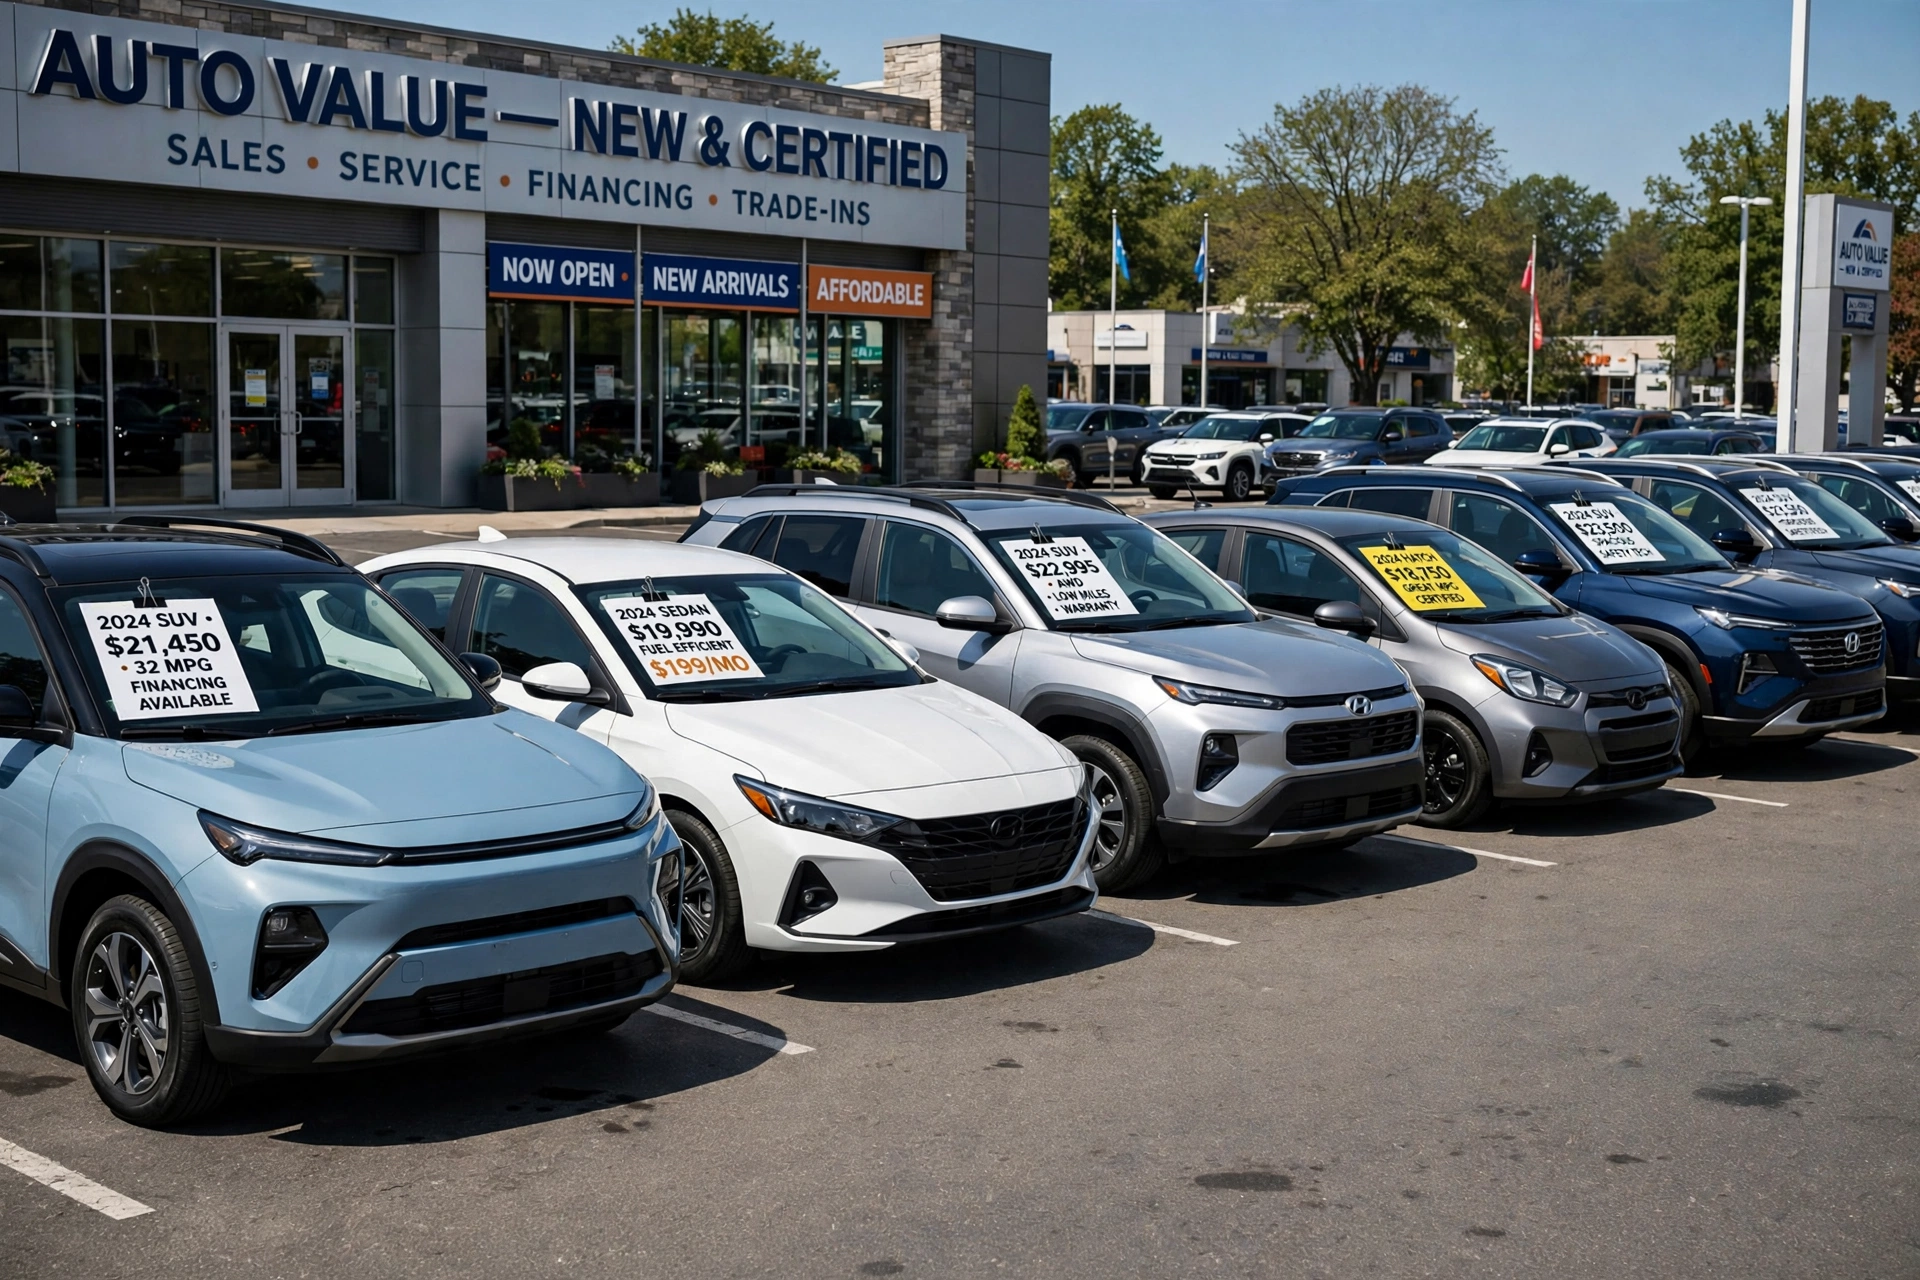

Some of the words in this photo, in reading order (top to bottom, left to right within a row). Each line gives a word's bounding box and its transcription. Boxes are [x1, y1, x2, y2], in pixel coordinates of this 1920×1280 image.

[30, 28, 255, 117] AUTO
[267, 56, 488, 142] VALUE
[569, 96, 688, 161] NEW
[697, 115, 731, 167] &
[742, 120, 949, 190] CERTIFIED
[168, 133, 286, 174] SALES
[339, 151, 481, 192] SERVICE
[528, 169, 693, 210] FINANCING
[732, 189, 871, 226] TRADE-INS
[1839, 241, 1863, 261] AUTO
[1864, 244, 1888, 264] VALUE
[502, 256, 555, 285] NOW
[560, 259, 615, 288] OPEN
[652, 265, 700, 292] NEW
[702, 269, 789, 298] ARRIVALS
[817, 278, 924, 307] AFFORDABLE
[1563, 510, 1593, 521] 2024
[1014, 547, 1050, 560] 2024
[1050, 545, 1079, 558] SUV
[1373, 553, 1402, 565] 2024
[1400, 552, 1439, 563] HATCH
[1025, 560, 1100, 579] $22,995
[1384, 565, 1452, 582] $18,750
[1057, 577, 1084, 589] AWD
[1052, 589, 1078, 602] LOW
[1079, 588, 1111, 601] MILES
[615, 606, 656, 620] 2024
[658, 604, 711, 617] SEDAN
[1061, 600, 1121, 615] WARRANTY
[97, 613, 151, 630] 2024
[155, 612, 198, 628] SUV
[628, 620, 722, 642] $19,990
[105, 632, 221, 658] $21,450
[639, 643, 674, 656] FUEL
[674, 639, 735, 653] EFFICIENT
[134, 659, 160, 675] 32
[164, 657, 213, 673] MPG
[650, 655, 750, 679] $199/MO
[130, 676, 228, 693] FINANCING
[139, 692, 234, 711] AVAILABLE
